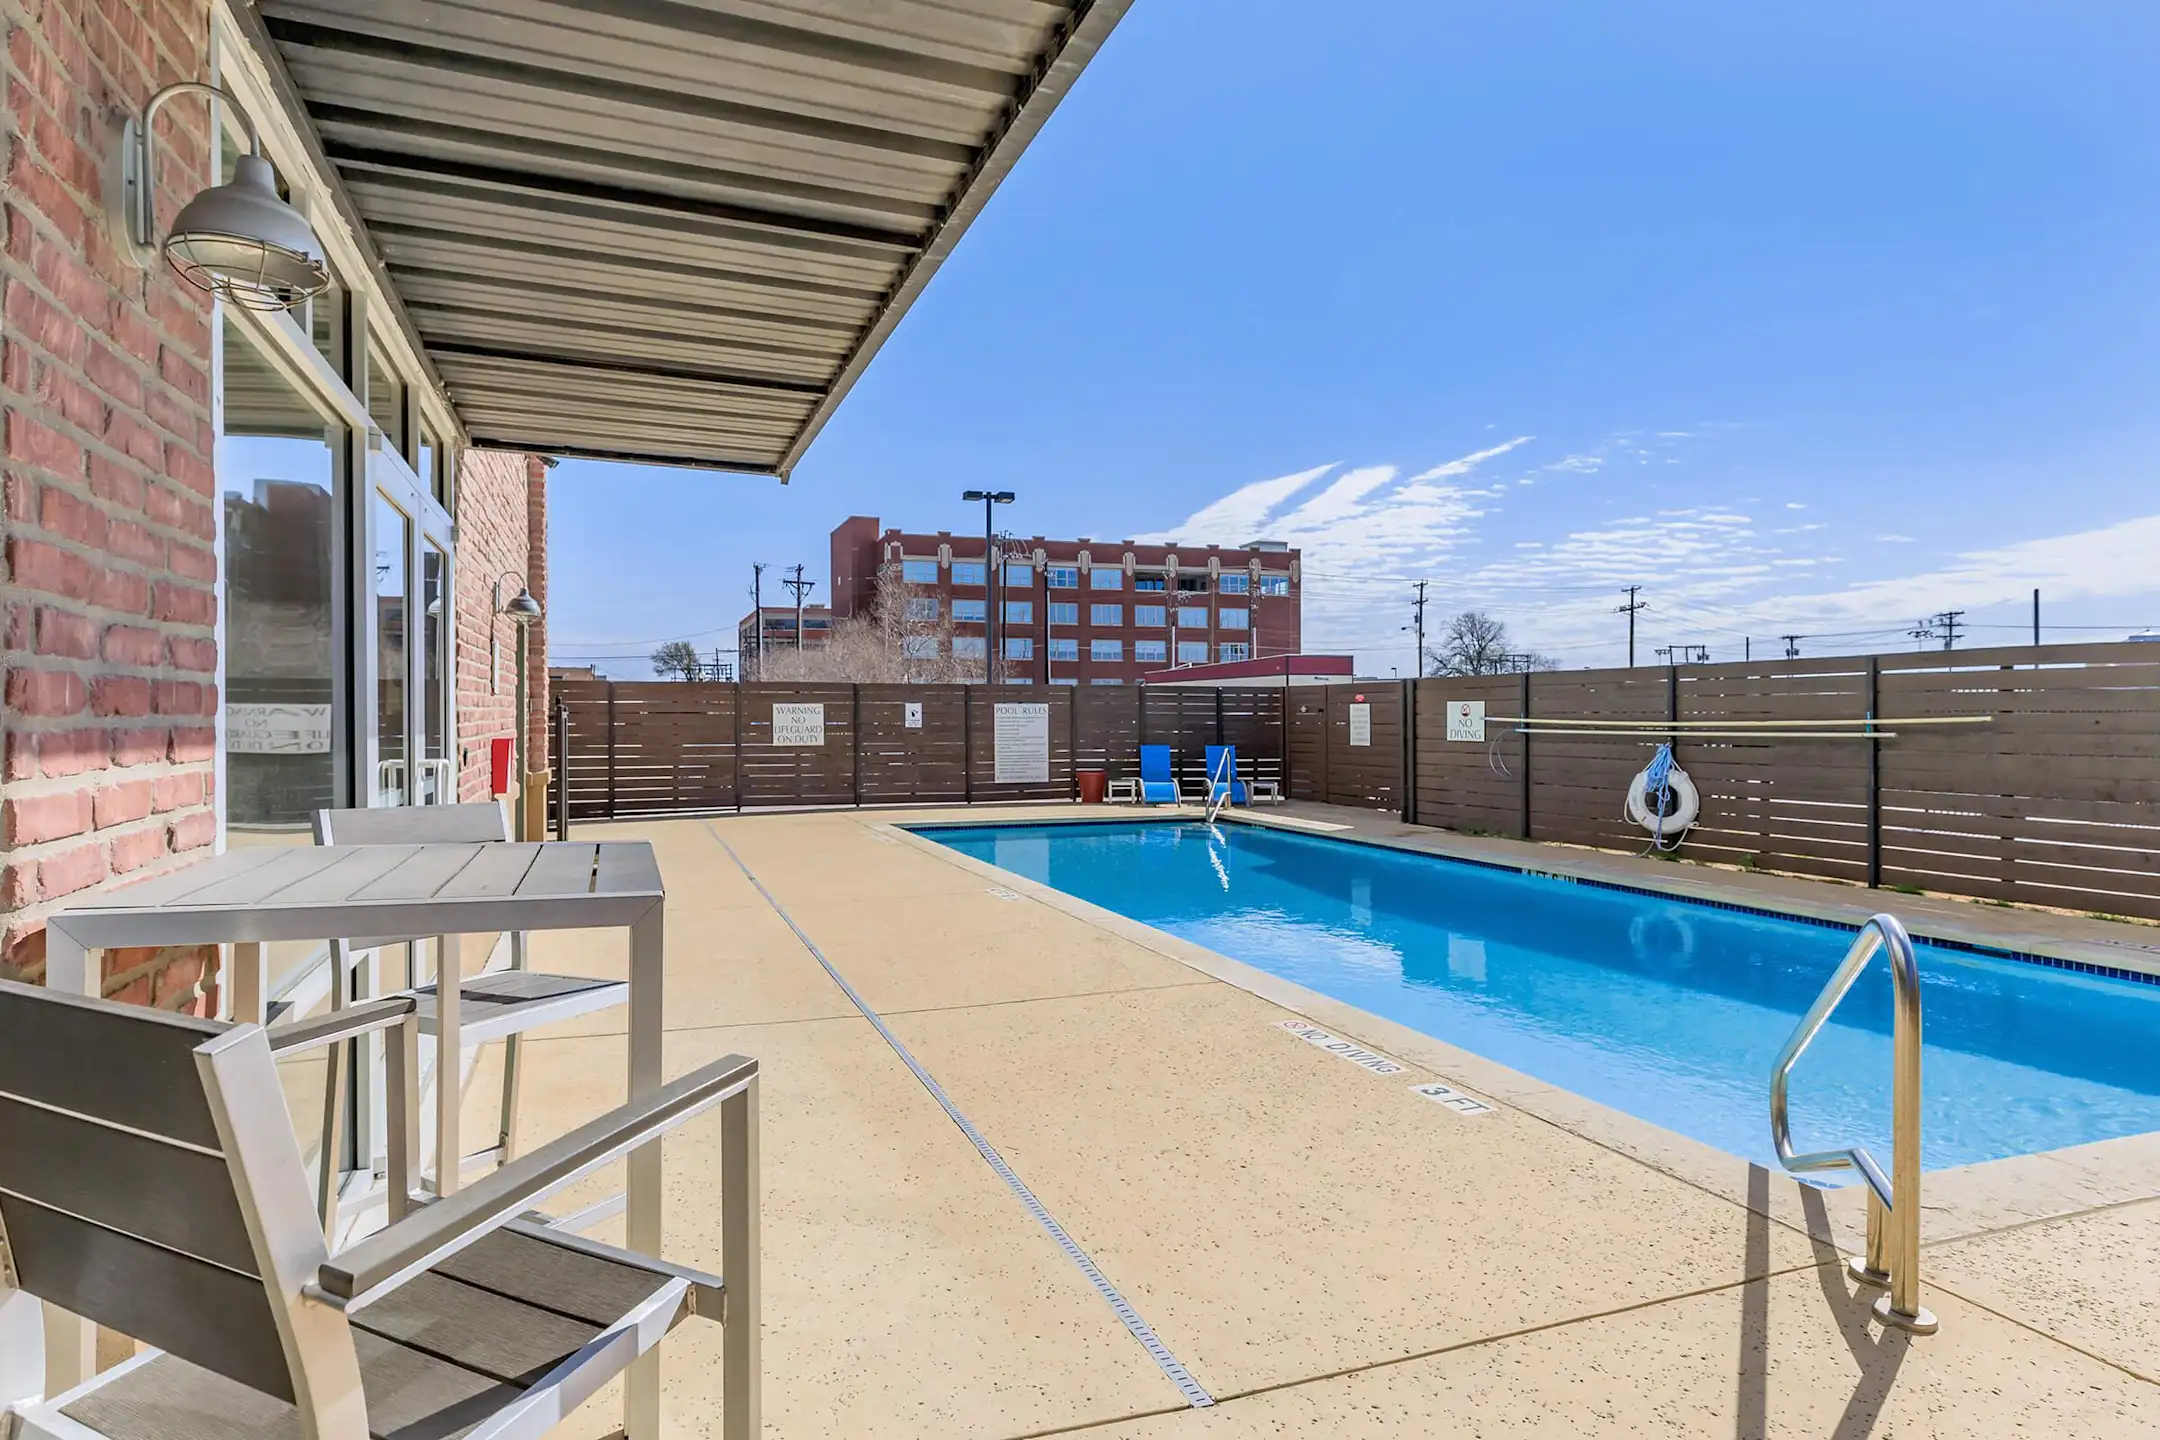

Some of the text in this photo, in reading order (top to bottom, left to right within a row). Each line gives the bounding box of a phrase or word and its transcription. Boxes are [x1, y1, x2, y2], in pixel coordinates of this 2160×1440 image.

[776, 706, 821, 715] WARNING
[791, 716, 805, 724] NO
[1459, 718, 1473, 727] NO
[775, 725, 822, 734] LIFEGUARD
[1450, 729, 1481, 739] DIVING
[777, 735, 818, 743] ON DUTY
[1297, 1028, 1401, 1074] NO DIVING
[1420, 1086, 1490, 1112] 3 FT
